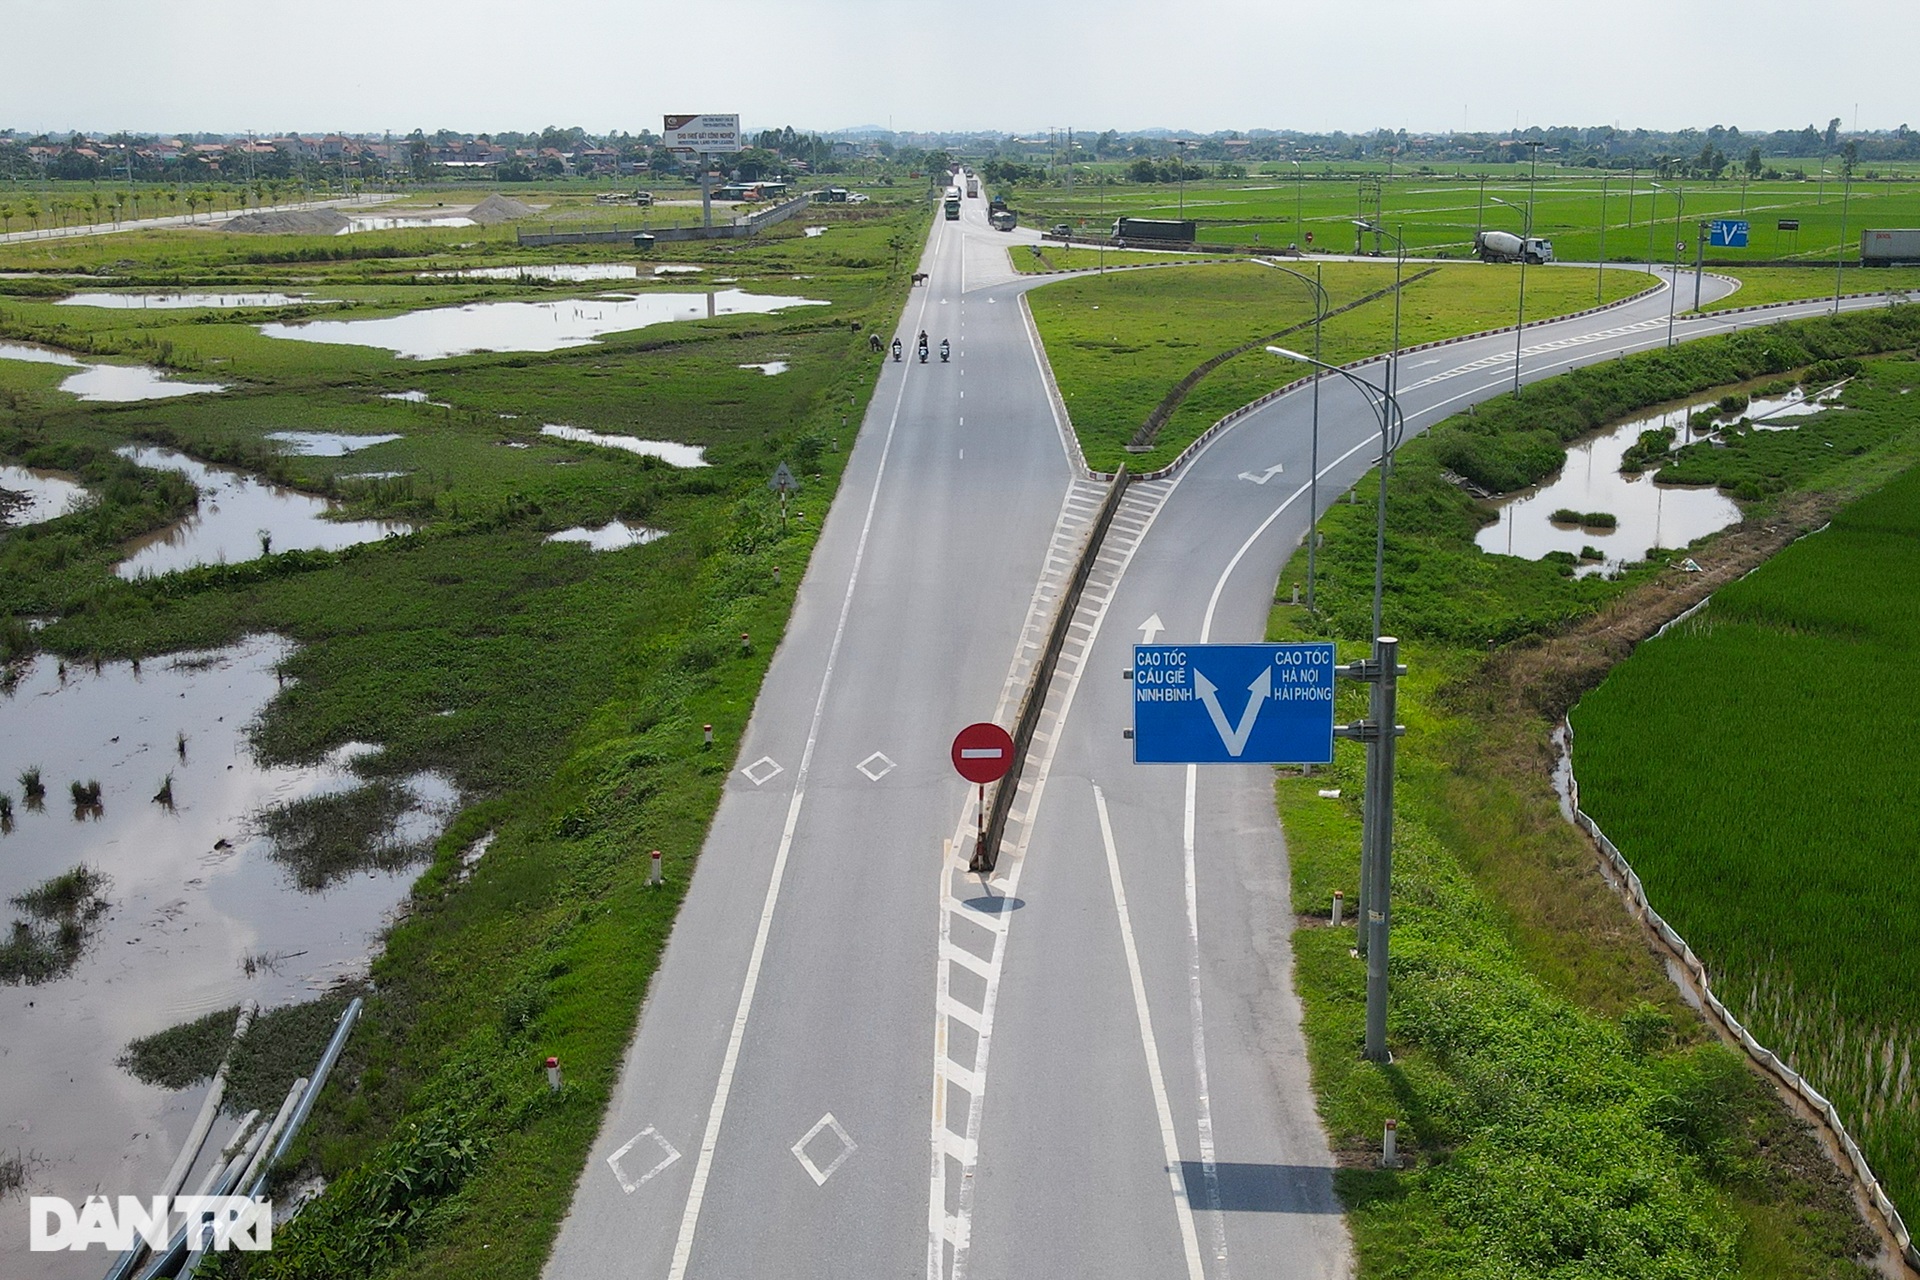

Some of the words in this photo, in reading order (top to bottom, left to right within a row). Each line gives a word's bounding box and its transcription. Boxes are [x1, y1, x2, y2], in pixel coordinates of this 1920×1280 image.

[1137, 652, 1160, 666] CAO
[1275, 651, 1302, 665] CAO
[1282, 666, 1298, 683] HÀ
[1137, 688, 1164, 702] NINH
[1165, 684, 1192, 702] BÌNH
[1295, 685, 1332, 701] PHÒNG
